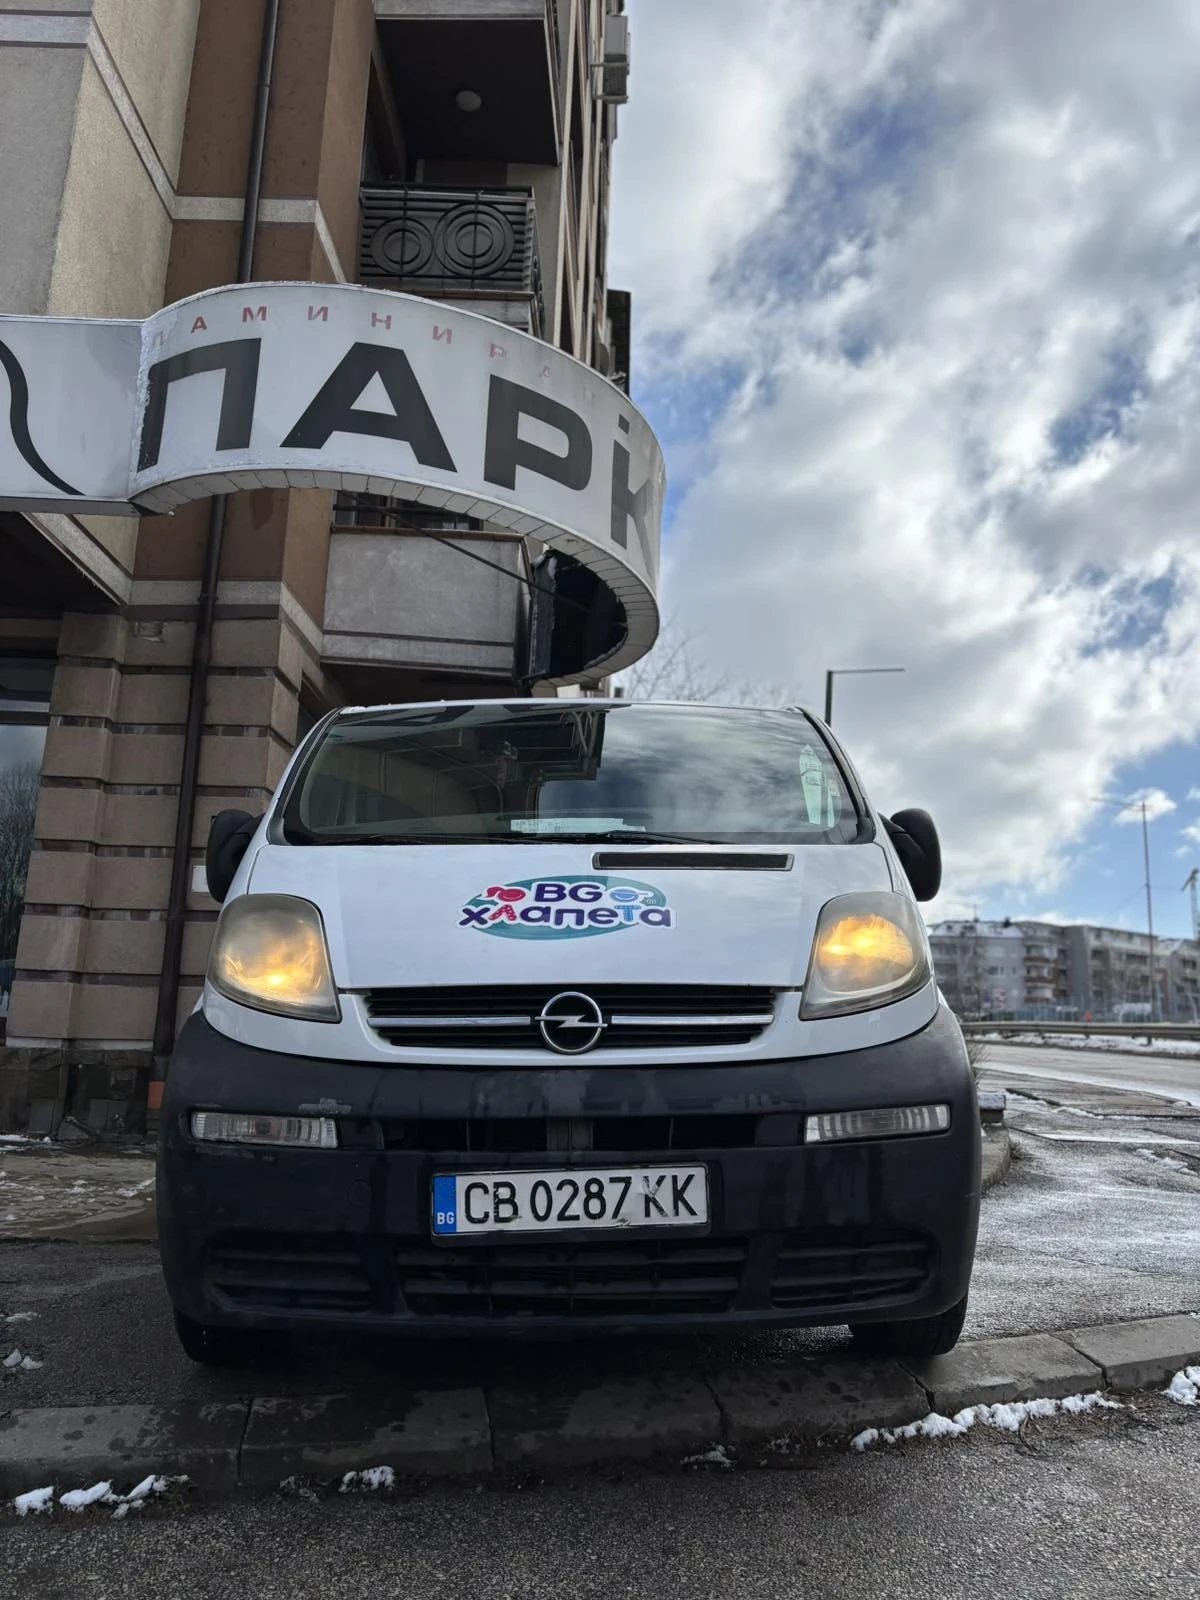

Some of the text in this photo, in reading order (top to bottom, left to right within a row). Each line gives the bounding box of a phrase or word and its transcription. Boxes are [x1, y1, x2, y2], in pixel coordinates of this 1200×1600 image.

[534, 883, 603, 903] BG
[529, 1176, 632, 1222] 0287
[640, 1173, 698, 1218] KK
[436, 1211, 455, 1225] BG
